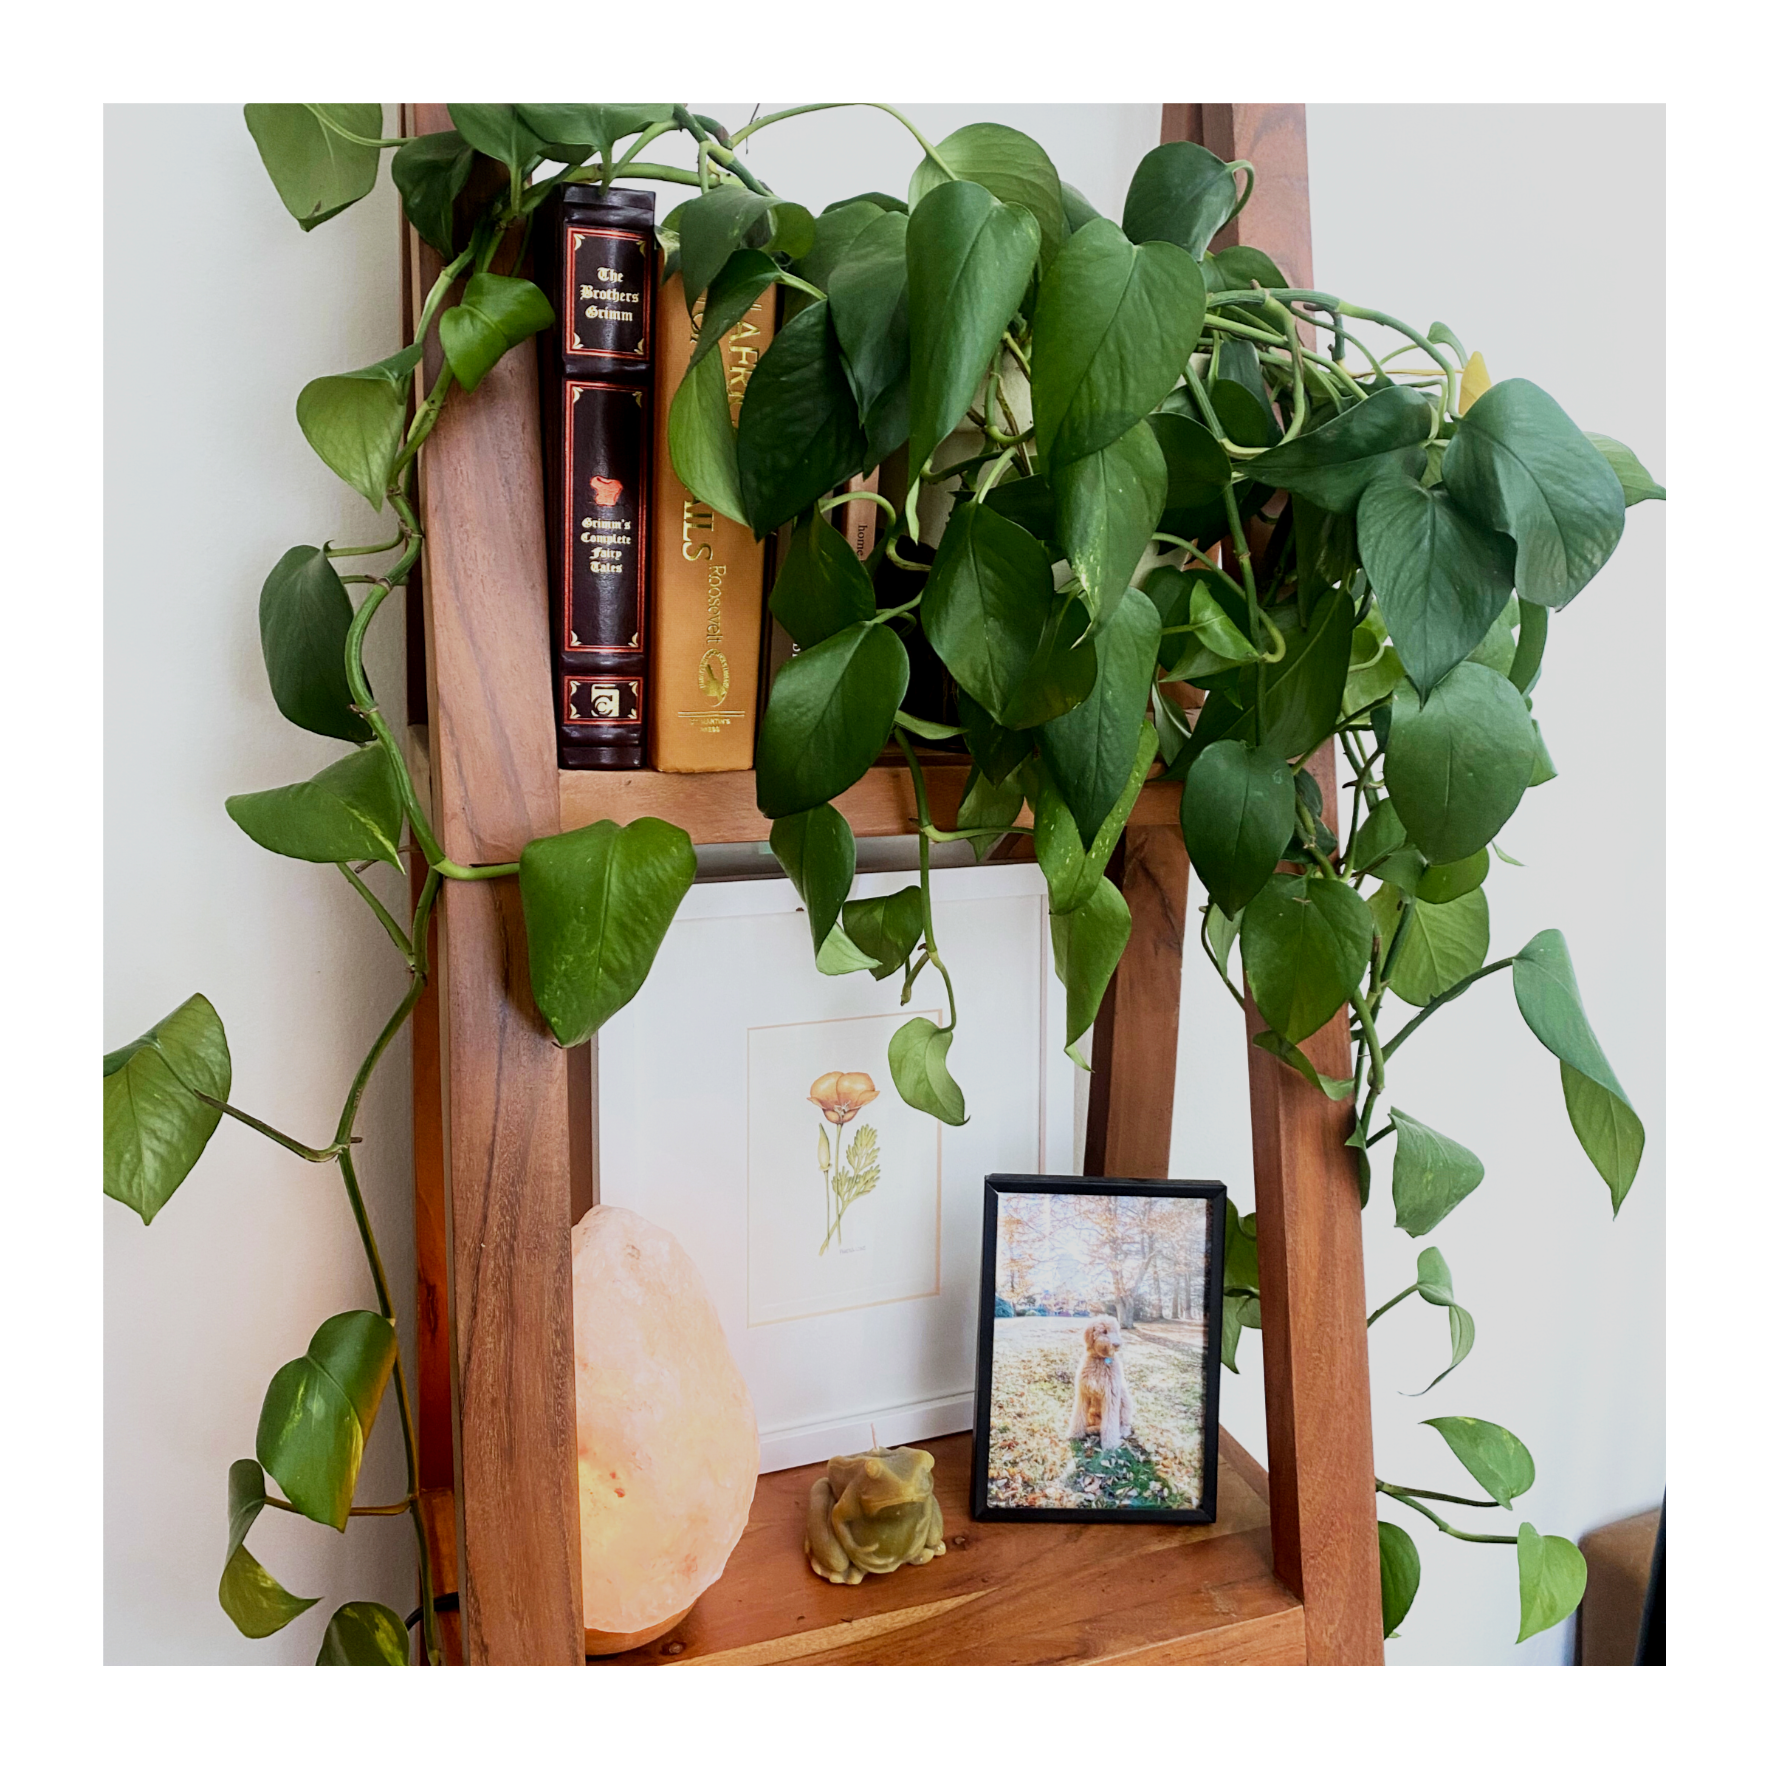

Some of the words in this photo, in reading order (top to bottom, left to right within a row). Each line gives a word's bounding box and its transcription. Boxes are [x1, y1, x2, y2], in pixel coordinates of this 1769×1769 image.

[596, 266, 624, 283] The
[580, 284, 639, 303] Brothers
[585, 304, 633, 321] Grimm
[581, 516, 631, 530] Grimm's
[580, 532, 631, 545] Complete
[856, 524, 868, 556] home
[589, 547, 622, 560] Fairy
[590, 561, 623, 573] Tales
[705, 565, 727, 645] Roosevelt
